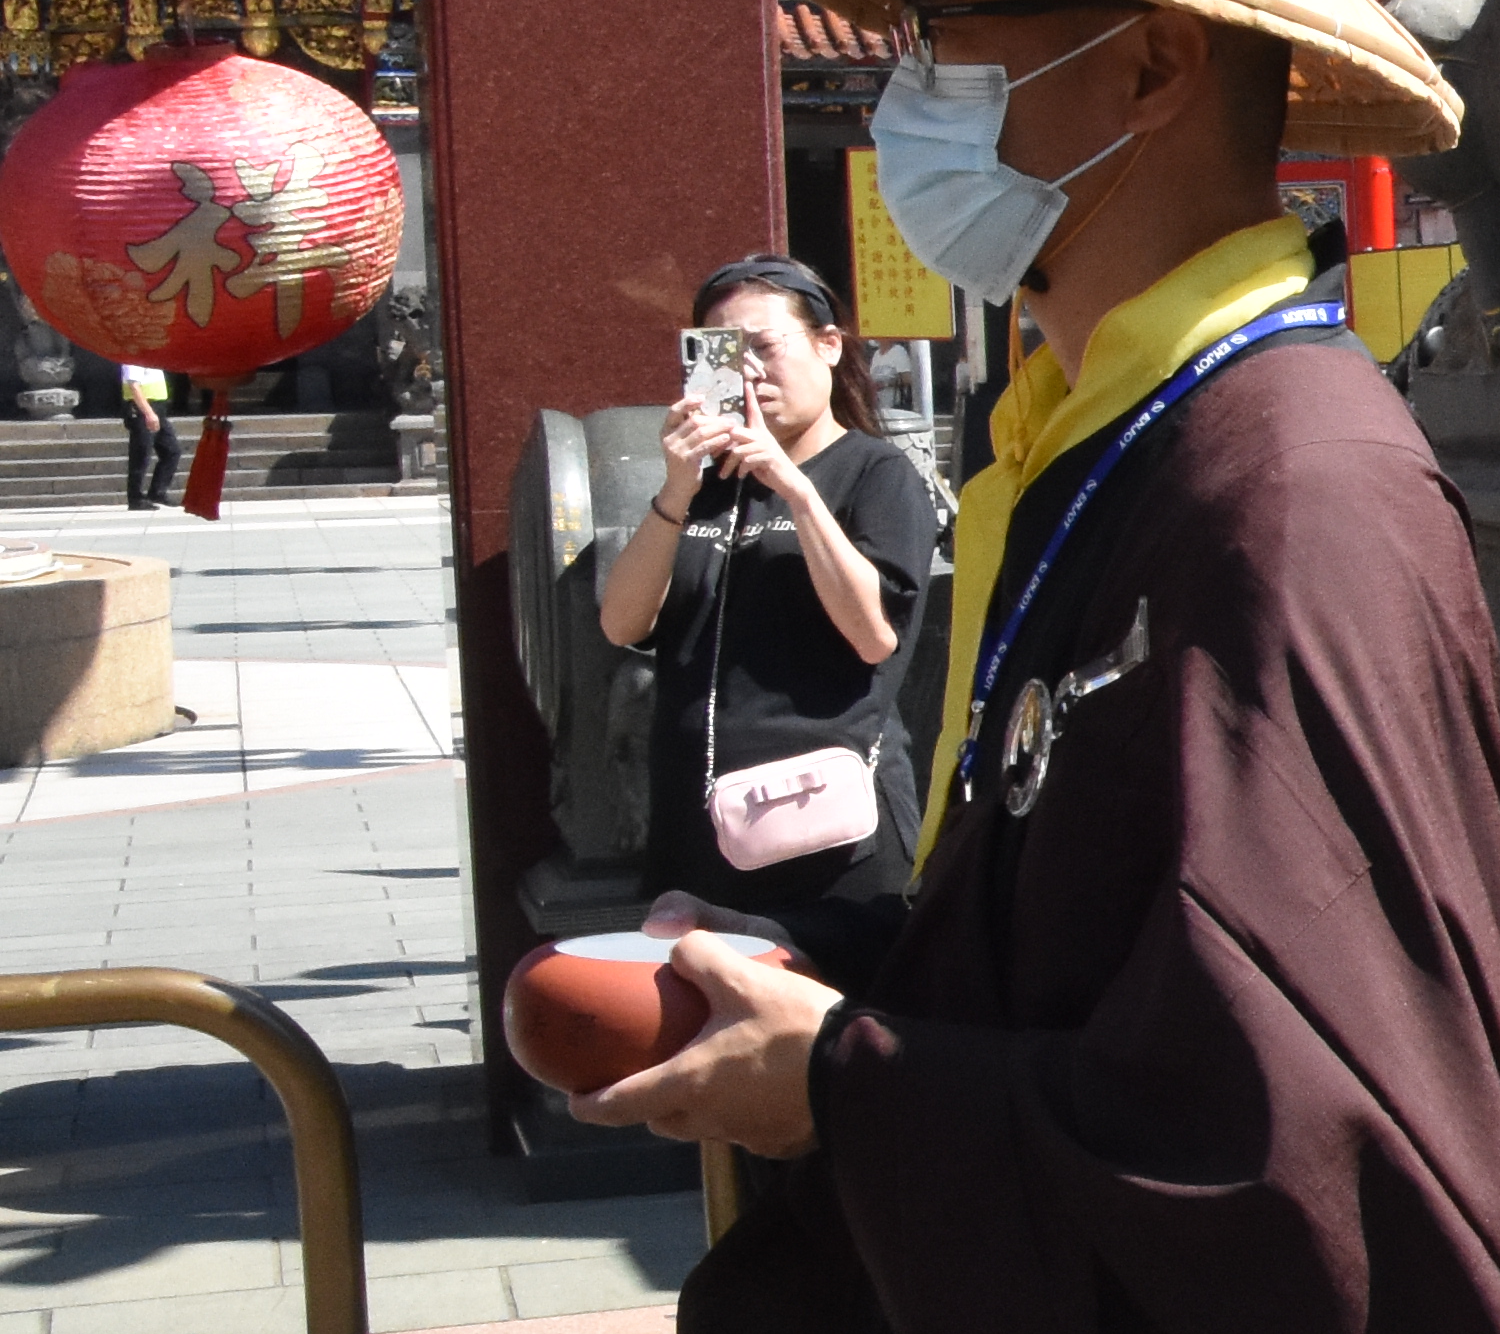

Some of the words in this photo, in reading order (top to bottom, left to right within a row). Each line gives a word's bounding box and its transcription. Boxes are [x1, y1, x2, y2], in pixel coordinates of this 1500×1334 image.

[127, 139, 354, 341] 祥
[1194, 341, 1232, 377] ENJOY
[1118, 411, 1152, 451] ENJOY
[1063, 491, 1088, 530] ENJOY
[1019, 574, 1041, 611] ENJOY
